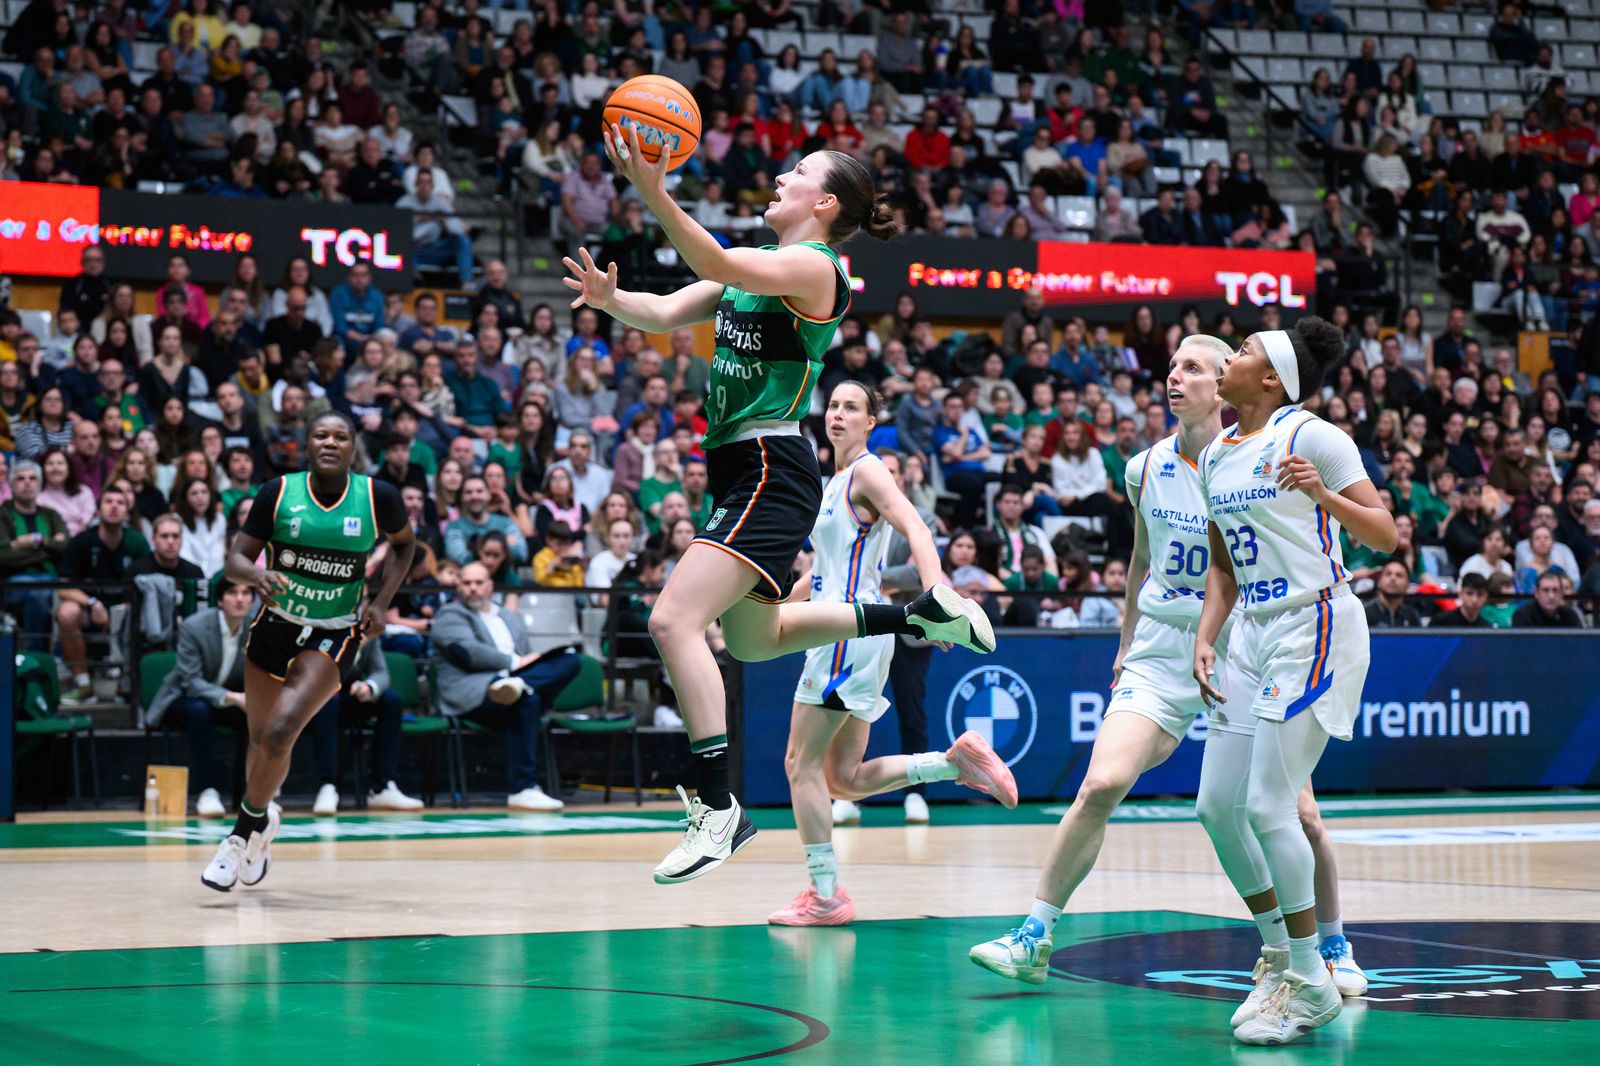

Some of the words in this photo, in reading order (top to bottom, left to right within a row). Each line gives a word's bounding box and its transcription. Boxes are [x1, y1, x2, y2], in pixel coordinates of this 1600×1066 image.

[169, 224, 253, 253] Future
[301, 228, 402, 270] TCL
[908, 262, 981, 288] Power
[1100, 272, 1172, 296] Future
[1216, 271, 1306, 309] TCL
[715, 384, 727, 426] 9
[1223, 503, 1251, 515] IMPULSA
[1245, 485, 1277, 501] LEÓN
[1151, 507, 1199, 525] CASTILLA
[1179, 524, 1208, 537] IMPULS
[1165, 540, 1209, 577] 30
[1225, 525, 1259, 569] 23
[296, 555, 355, 579] PROBITAS
[288, 578, 344, 602] VENTUT
[959, 670, 1025, 702] BMW
[1362, 686, 1531, 739] remium
